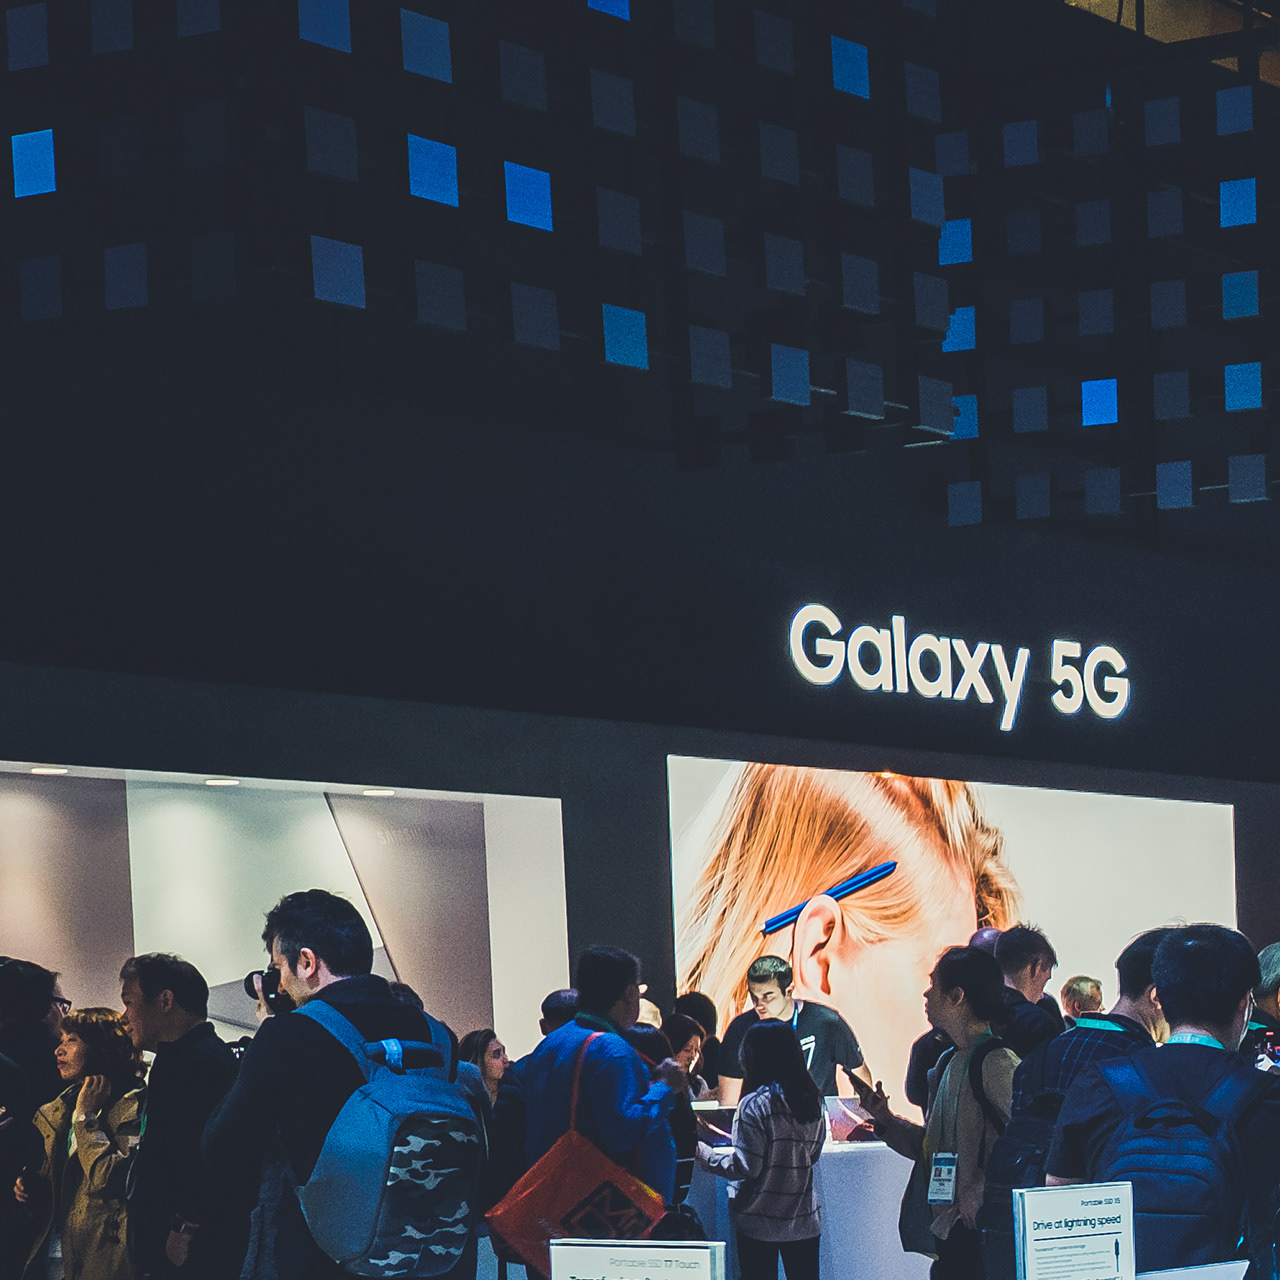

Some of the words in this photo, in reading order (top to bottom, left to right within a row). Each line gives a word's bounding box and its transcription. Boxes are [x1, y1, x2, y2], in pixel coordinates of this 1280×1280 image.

[789, 603, 1030, 731] Galaxy
[1051, 638, 1131, 719] 5G
[1033, 1220, 1053, 1231] Drive
[1054, 1220, 1063, 1229] at
[1064, 1216, 1096, 1231] lightning
[1098, 1214, 1121, 1227] speed
[674, 1259, 700, 1269] Touch
